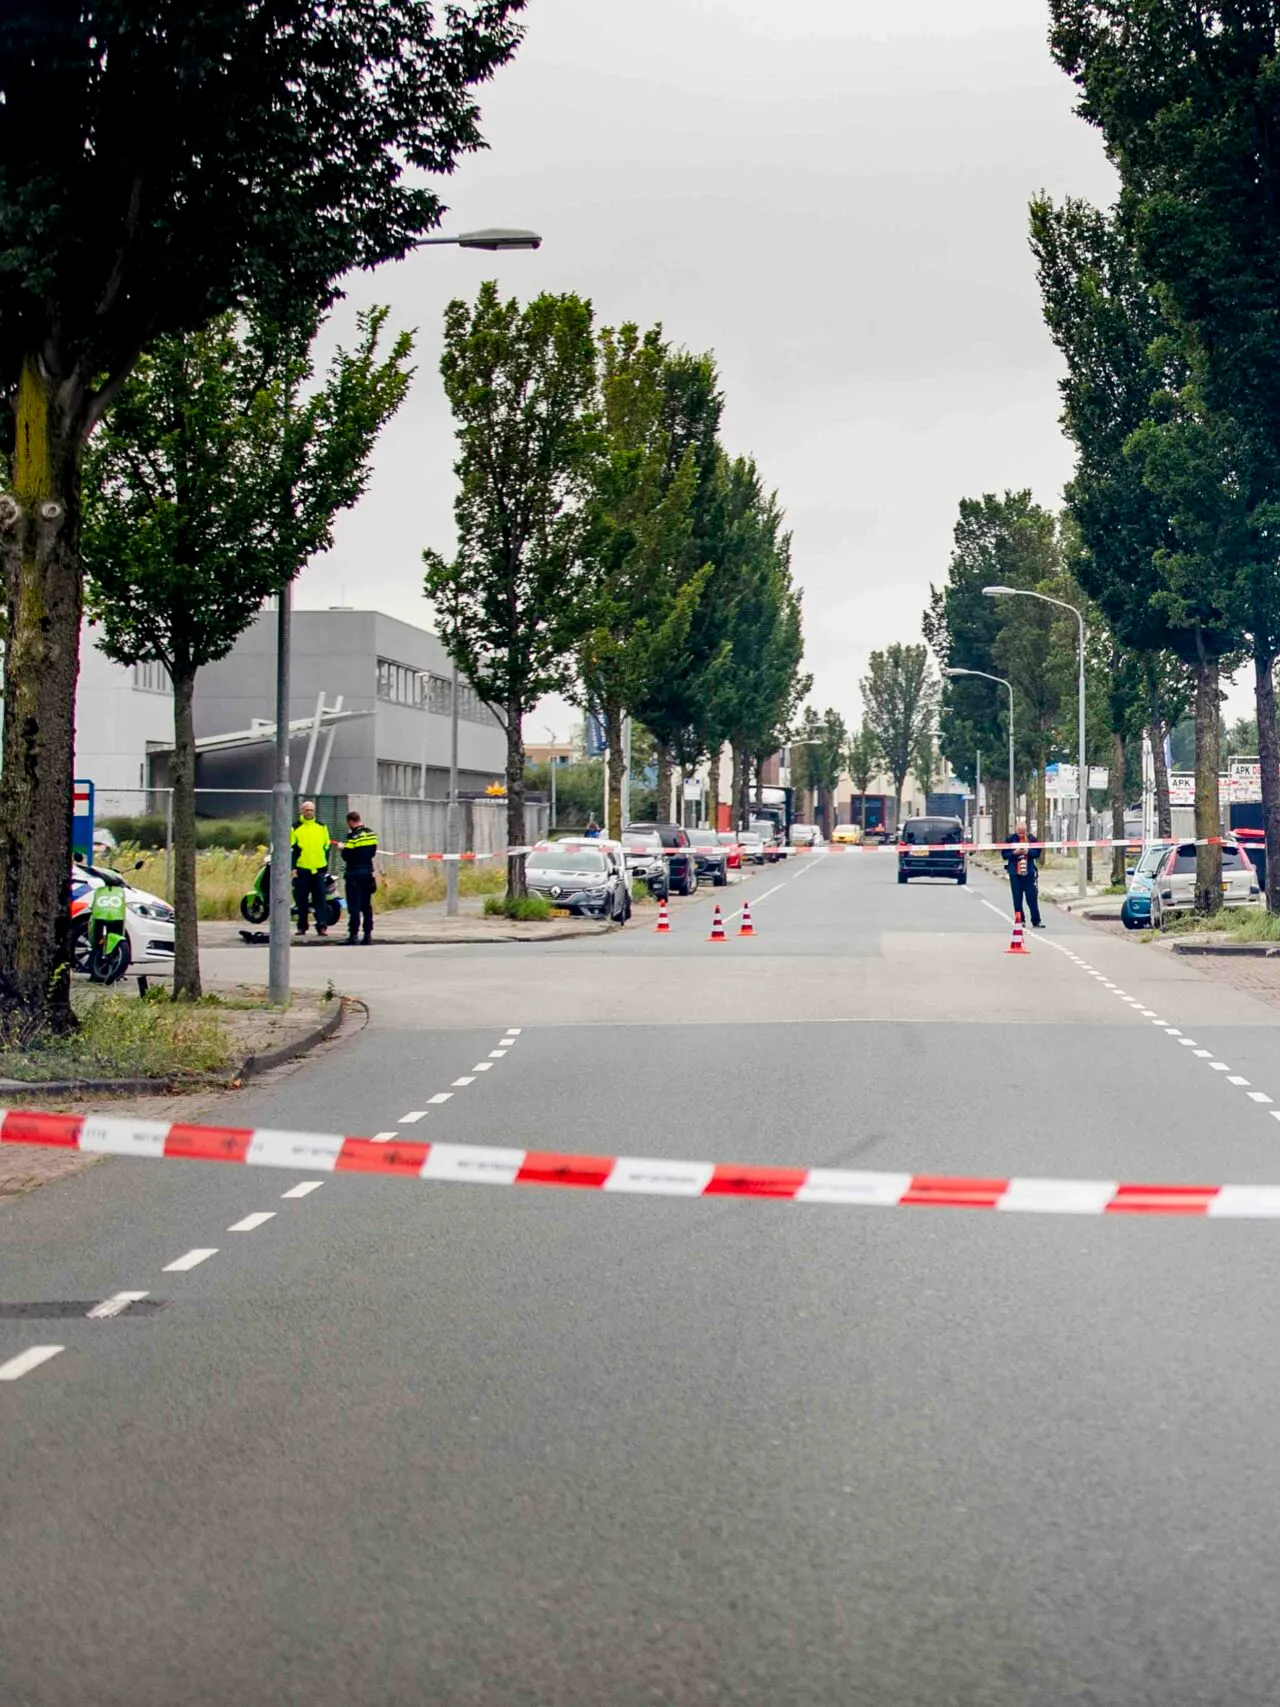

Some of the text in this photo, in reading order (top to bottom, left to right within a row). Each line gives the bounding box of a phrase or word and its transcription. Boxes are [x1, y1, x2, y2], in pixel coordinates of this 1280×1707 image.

[1235, 765, 1250, 775] APK
[1172, 779, 1191, 787] APK
[97, 896, 122, 907] GO
